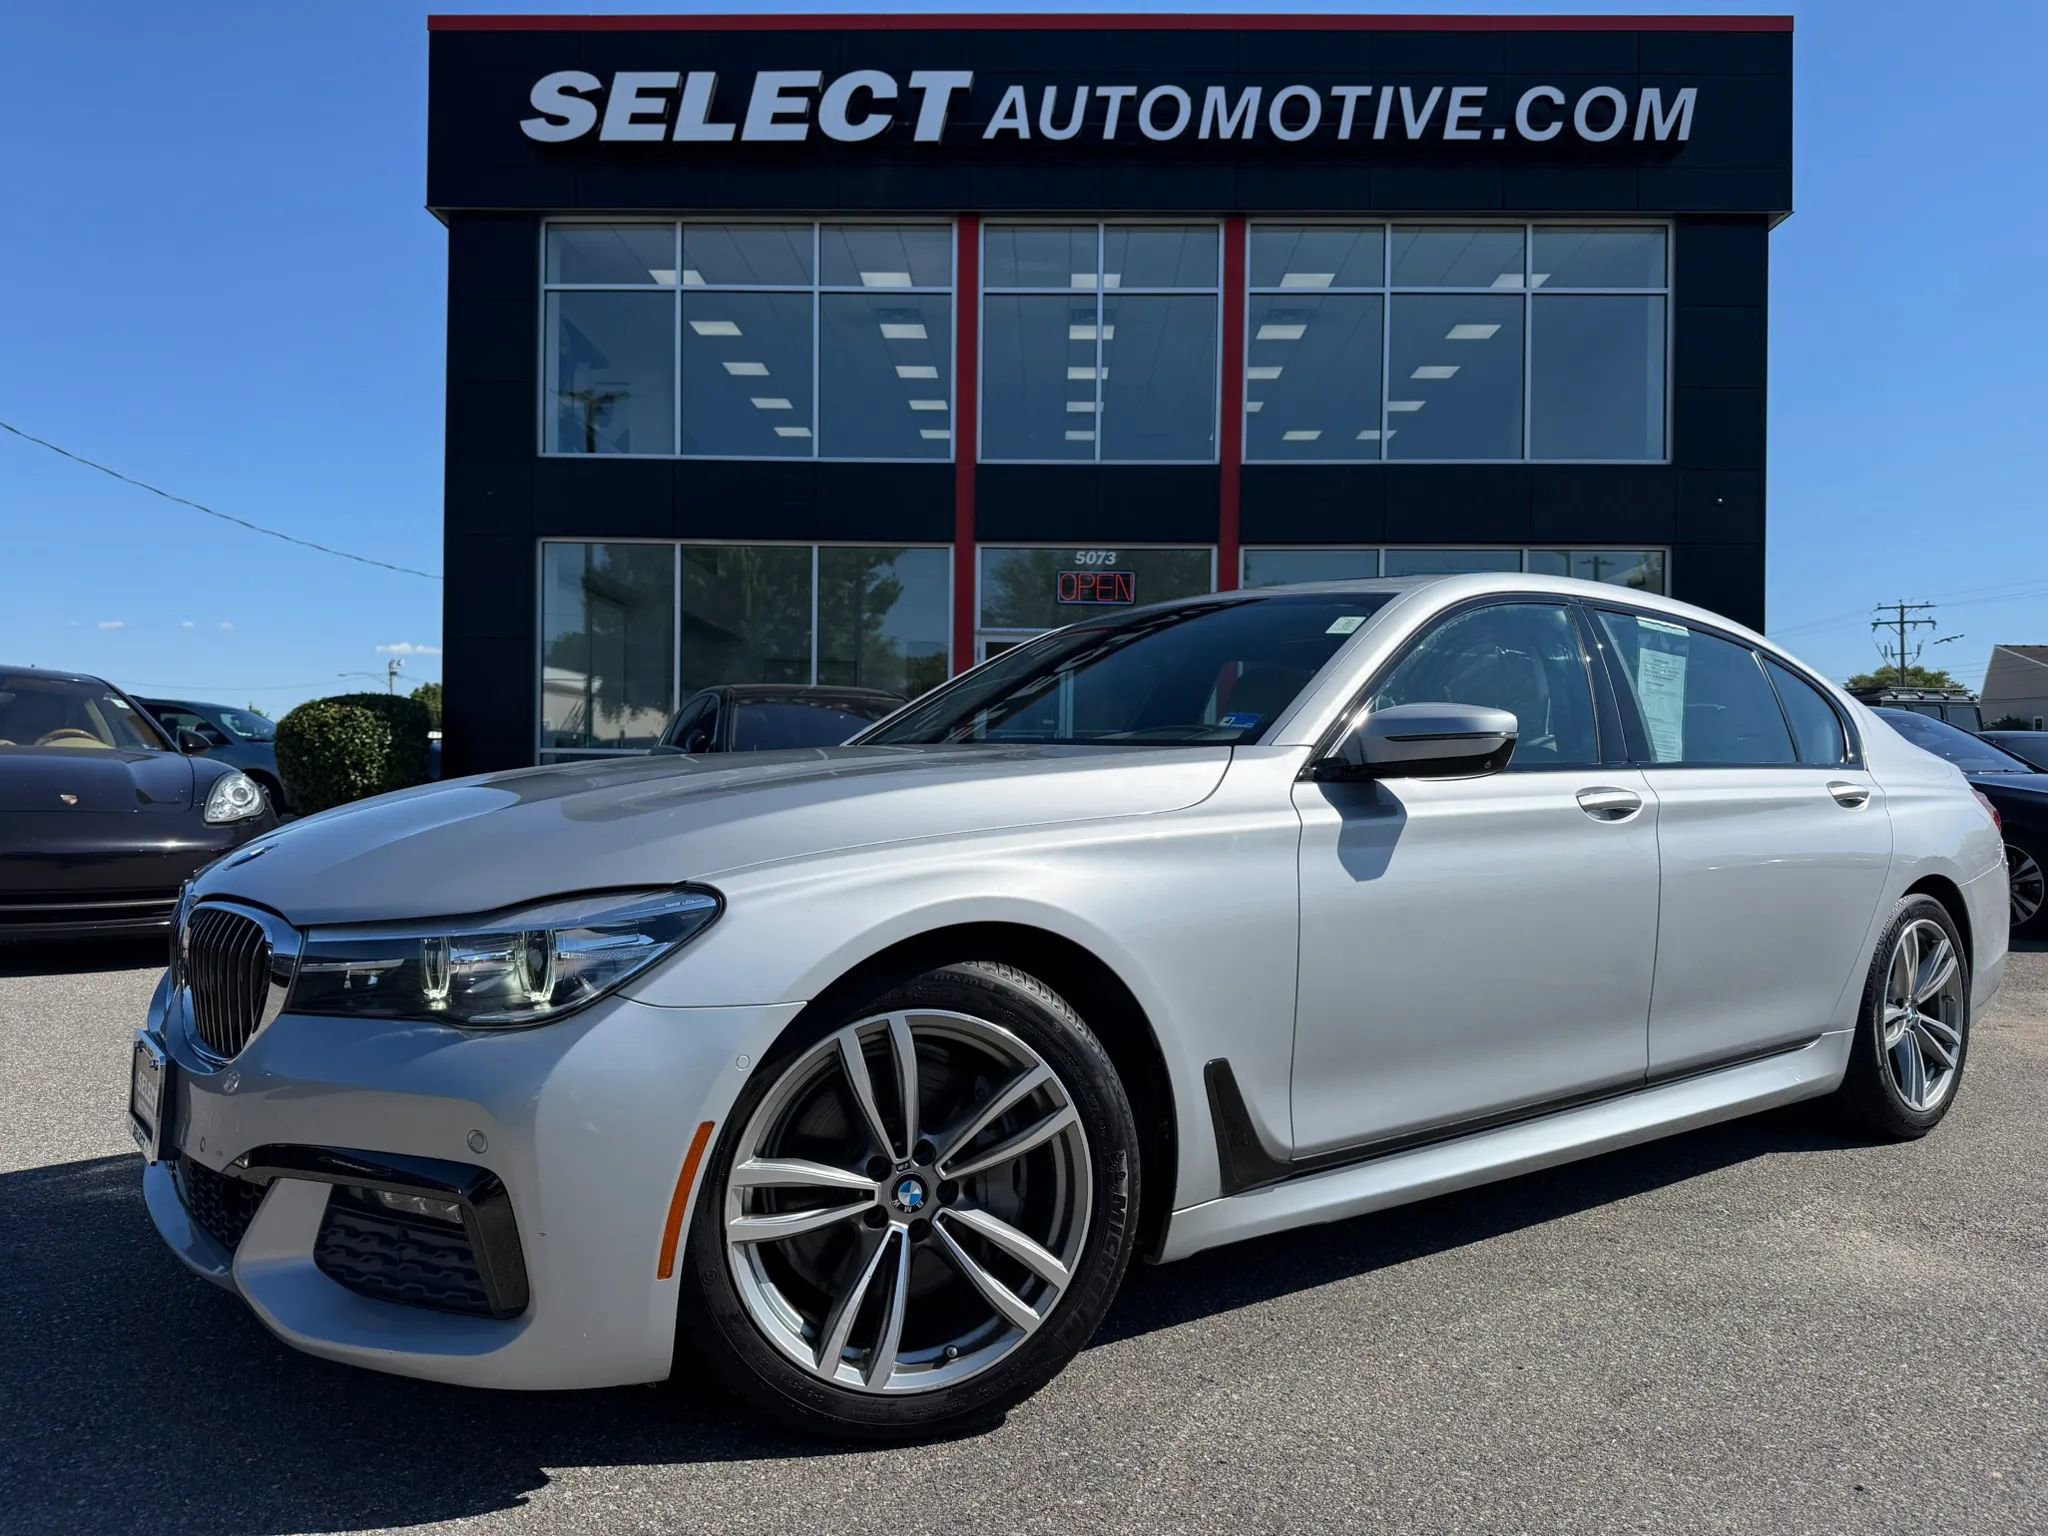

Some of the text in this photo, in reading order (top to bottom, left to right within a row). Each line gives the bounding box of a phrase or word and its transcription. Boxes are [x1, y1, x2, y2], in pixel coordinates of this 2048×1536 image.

[519, 69, 1698, 143] SELECT AUTOMOTIVE.COM
[1075, 551, 1117, 565] 5073
[1059, 573, 1133, 601] OPEN
[892, 1199, 924, 1213] BMW
